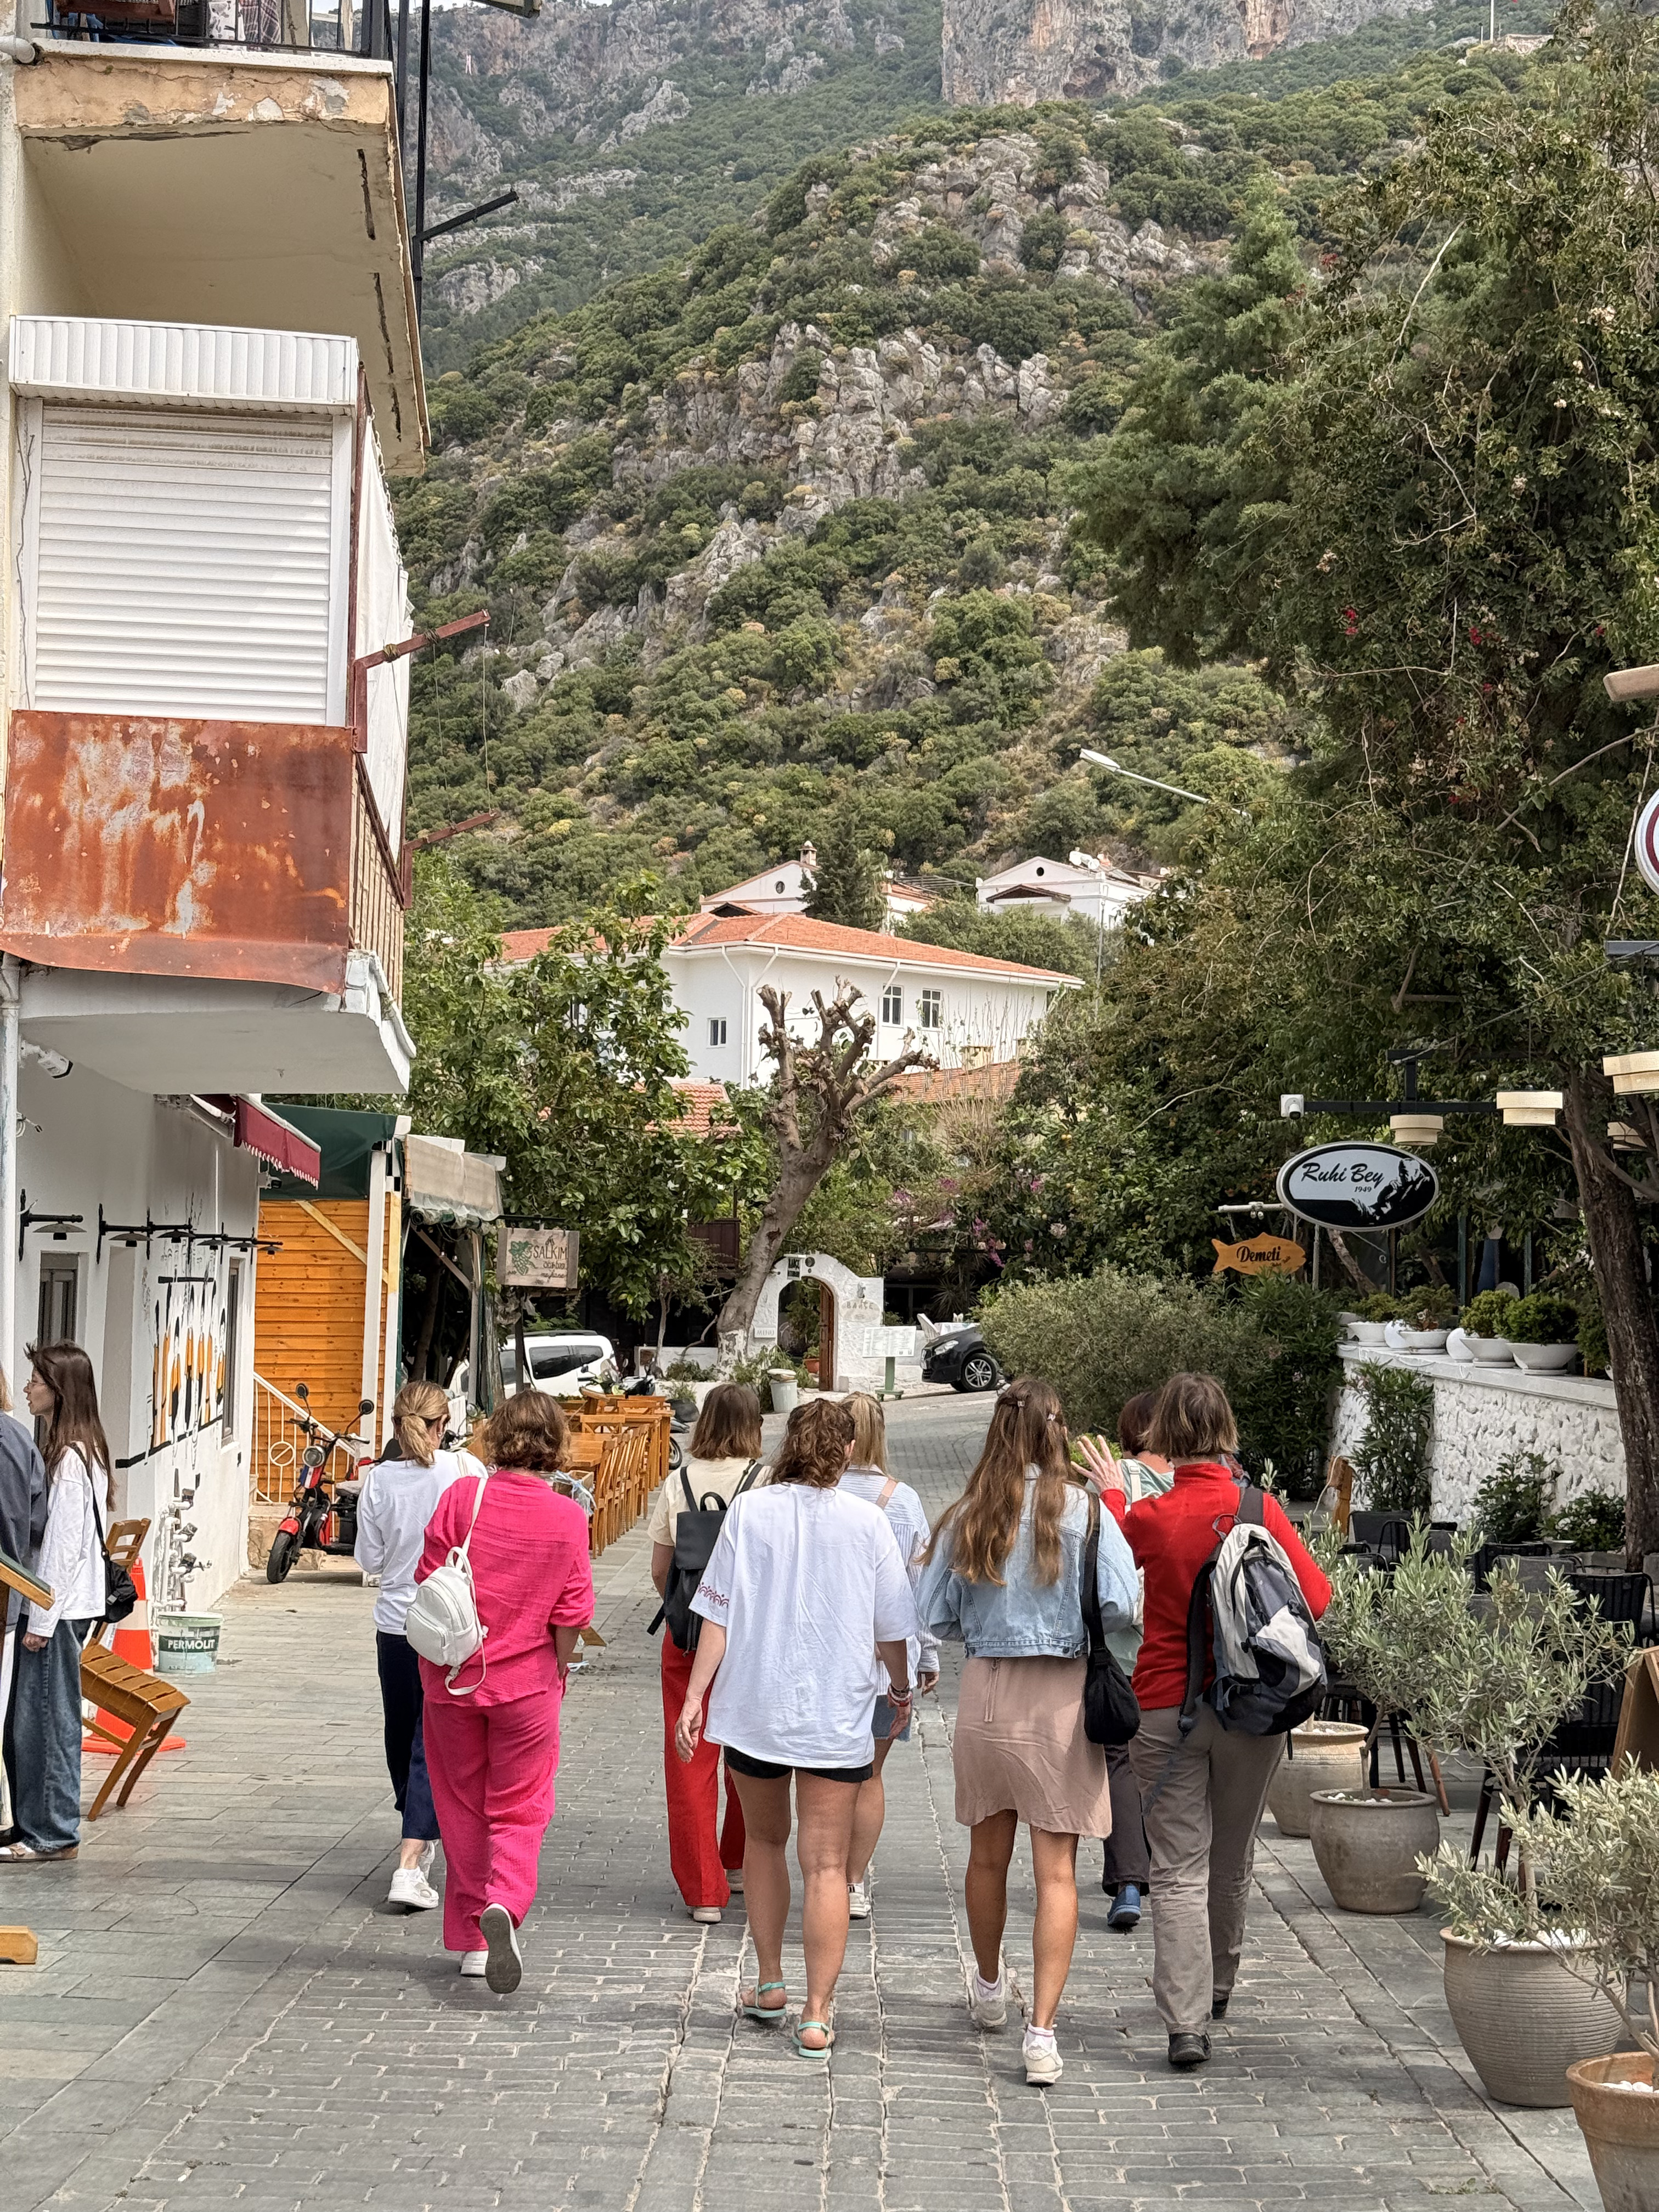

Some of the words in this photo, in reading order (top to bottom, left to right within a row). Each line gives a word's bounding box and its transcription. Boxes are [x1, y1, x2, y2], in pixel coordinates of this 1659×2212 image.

[1301, 1163, 1347, 1182] Ruhi
[1350, 1163, 1385, 1189] Bey
[533, 1245, 567, 1260] SALKIM
[1237, 1245, 1282, 1262] Demeti
[168, 1639, 216, 1650] PERMOLIT
